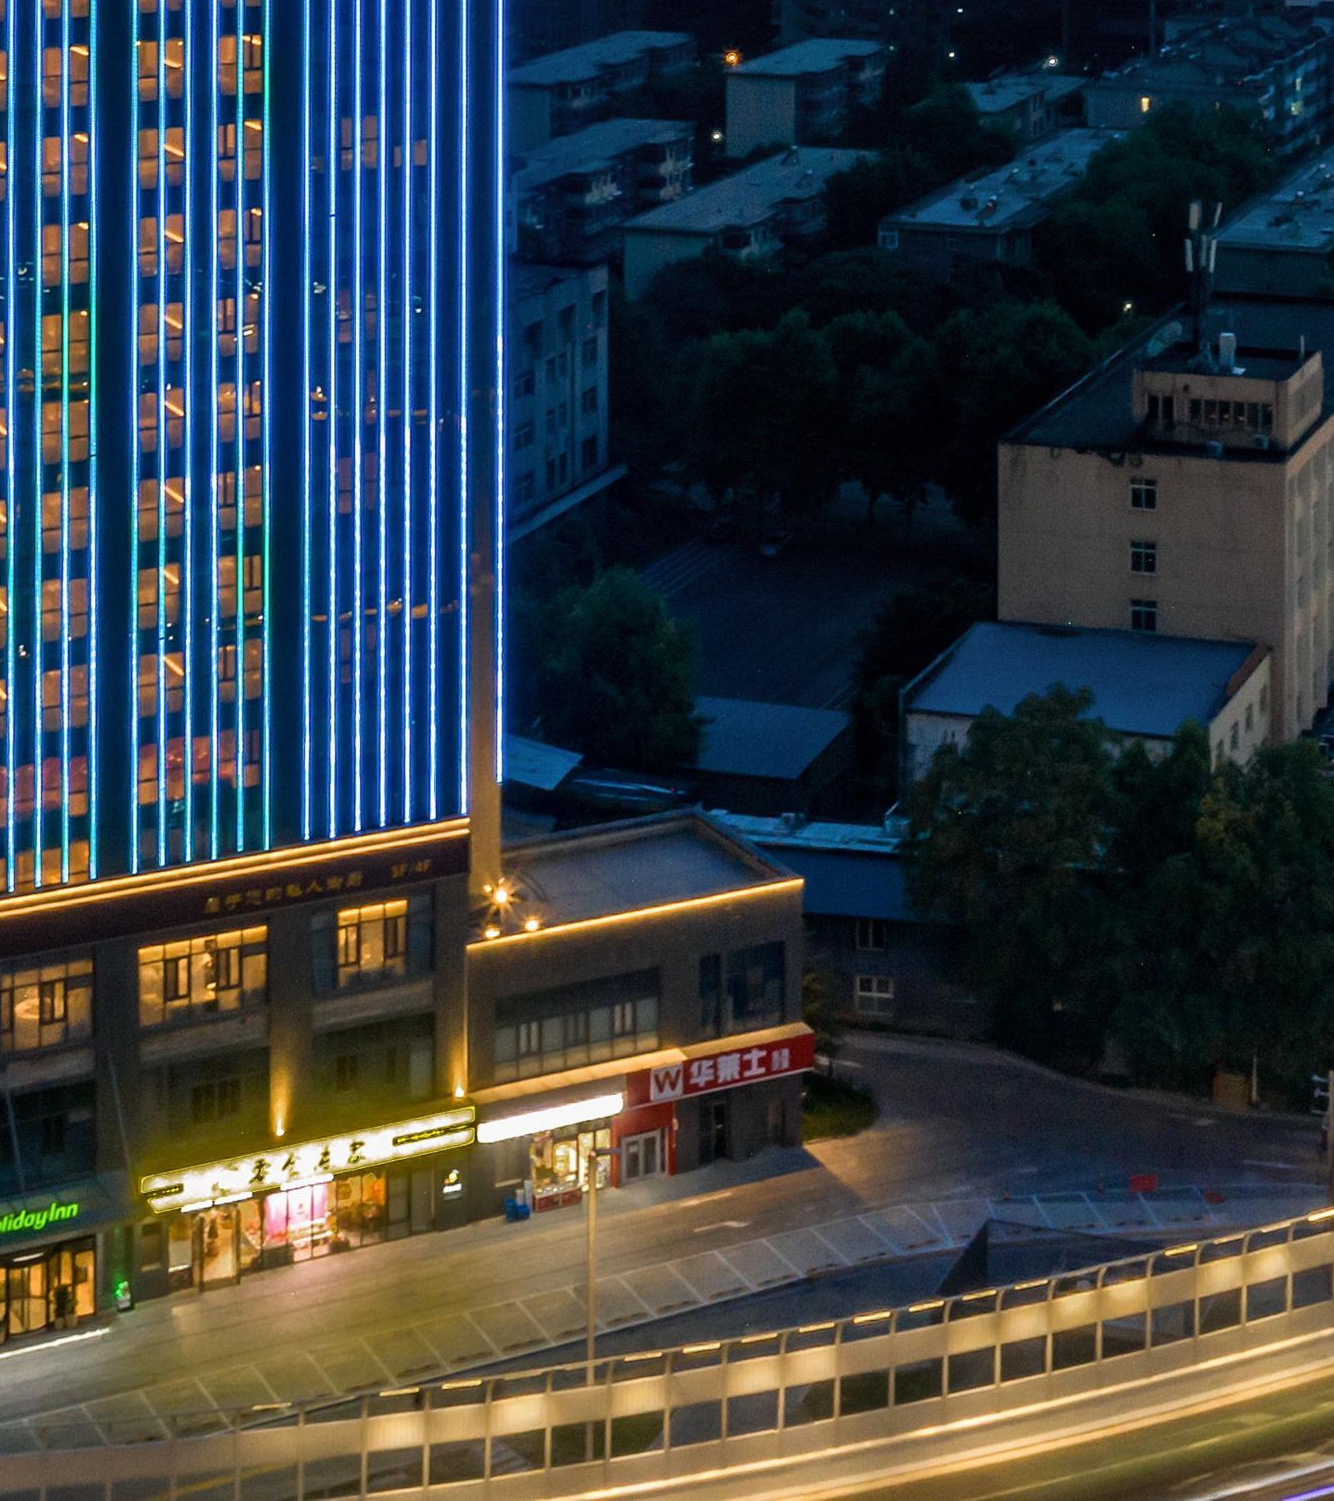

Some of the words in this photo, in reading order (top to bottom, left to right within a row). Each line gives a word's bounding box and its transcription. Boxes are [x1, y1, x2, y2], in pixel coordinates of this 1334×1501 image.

[653, 1069, 681, 1094] W
[689, 1048, 767, 1087] 华莱士
[48, 1202, 79, 1222] Inn
